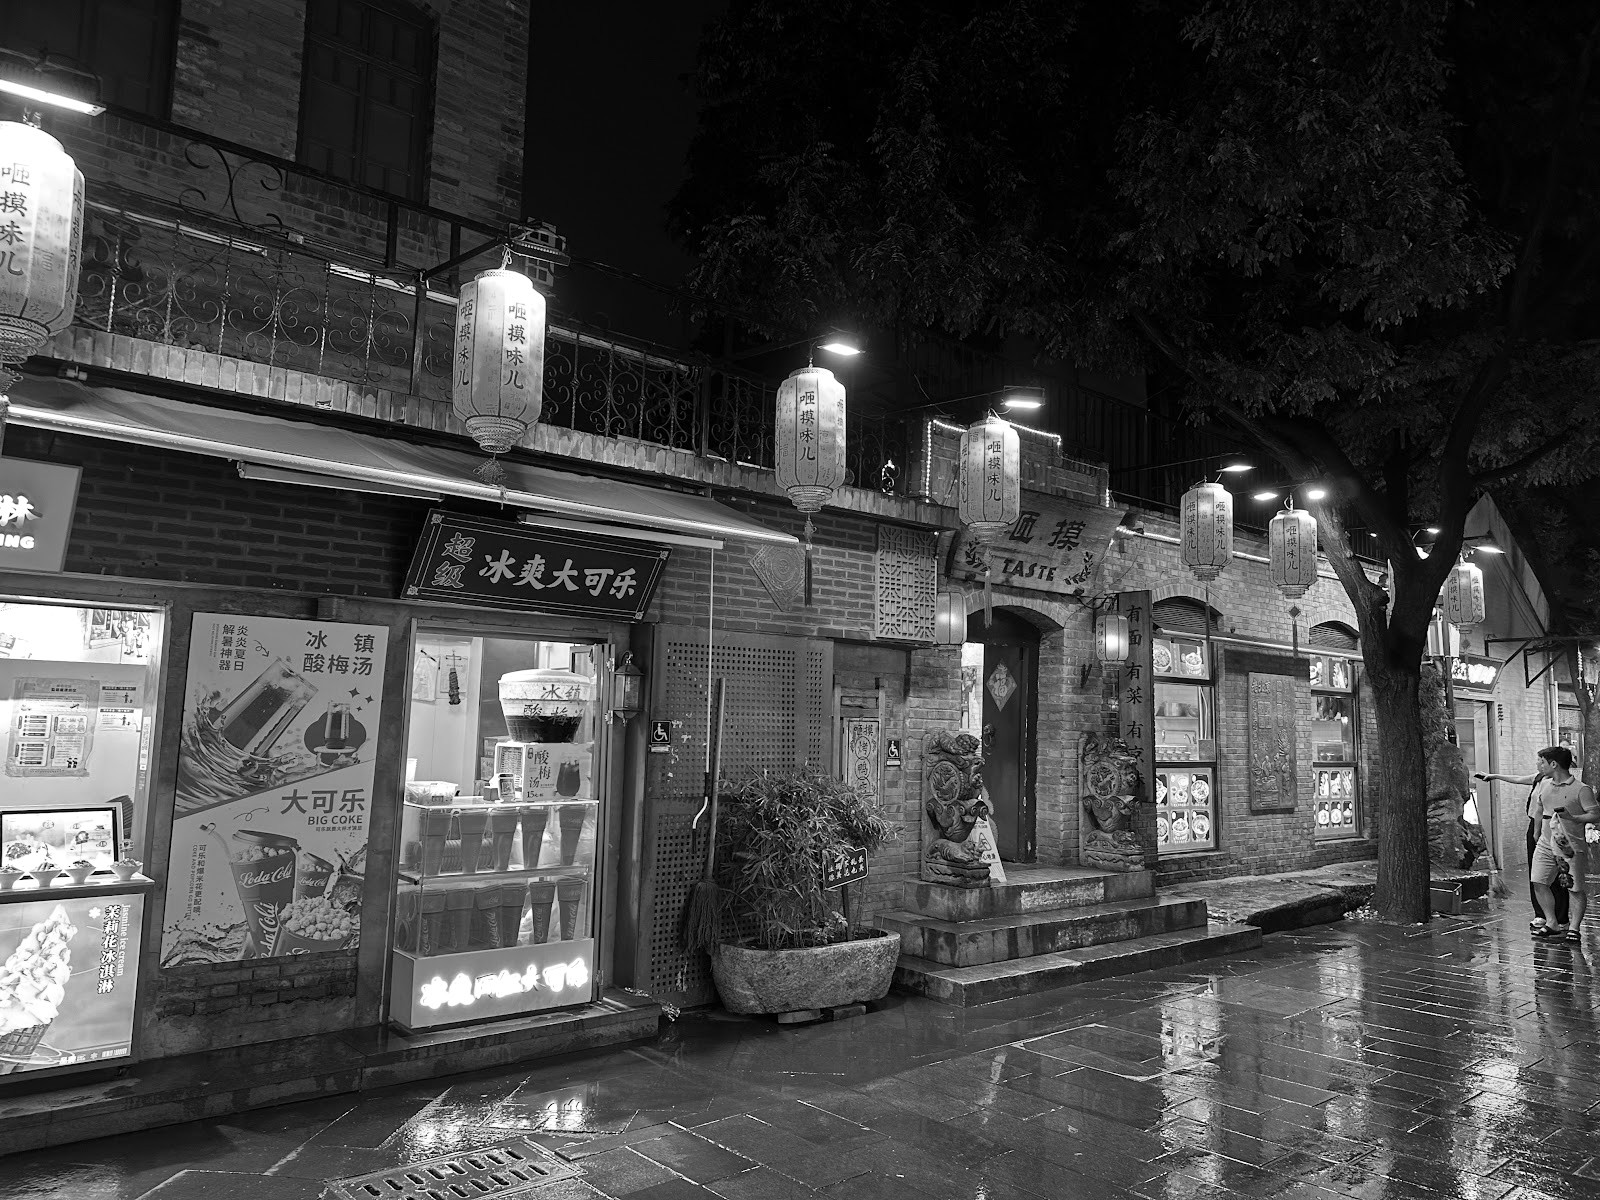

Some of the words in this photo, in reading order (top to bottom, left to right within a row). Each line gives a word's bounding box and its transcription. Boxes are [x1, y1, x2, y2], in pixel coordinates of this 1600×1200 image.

[0, 162, 30, 277] 咂摸味儿
[456, 299, 474, 389] 咂摸味儿
[504, 301, 528, 390] 咂摸味儿
[800, 390, 816, 461] 咂摸味儿
[987, 440, 1001, 501] 咂摸味儿
[1186, 501, 1197, 550] 咂摸味儿
[1215, 501, 1226, 550] 咂摸味儿
[1286, 525, 1299, 570] 咂摸味儿
[431, 531, 476, 588] 超级
[478, 549, 637, 599] 冰爽大可乐
[1002, 558, 1057, 582] TASTE
[219, 624, 235, 671] 解暑神器
[234, 625, 248, 671] 炎炎夏日
[302, 654, 373, 676] 酸梅汤
[540, 683, 581, 706] 冰镇
[525, 749, 551, 788] 酸梅汤
[280, 789, 365, 815] 大可乐
[308, 816, 328, 825] BIG
[331, 815, 363, 824] COKE
[121, 904, 131, 936] Jasmine
[97, 905, 122, 995] 茉莉花冰淇淋
[116, 950, 127, 977] cream
[120, 938, 128, 950] ice
